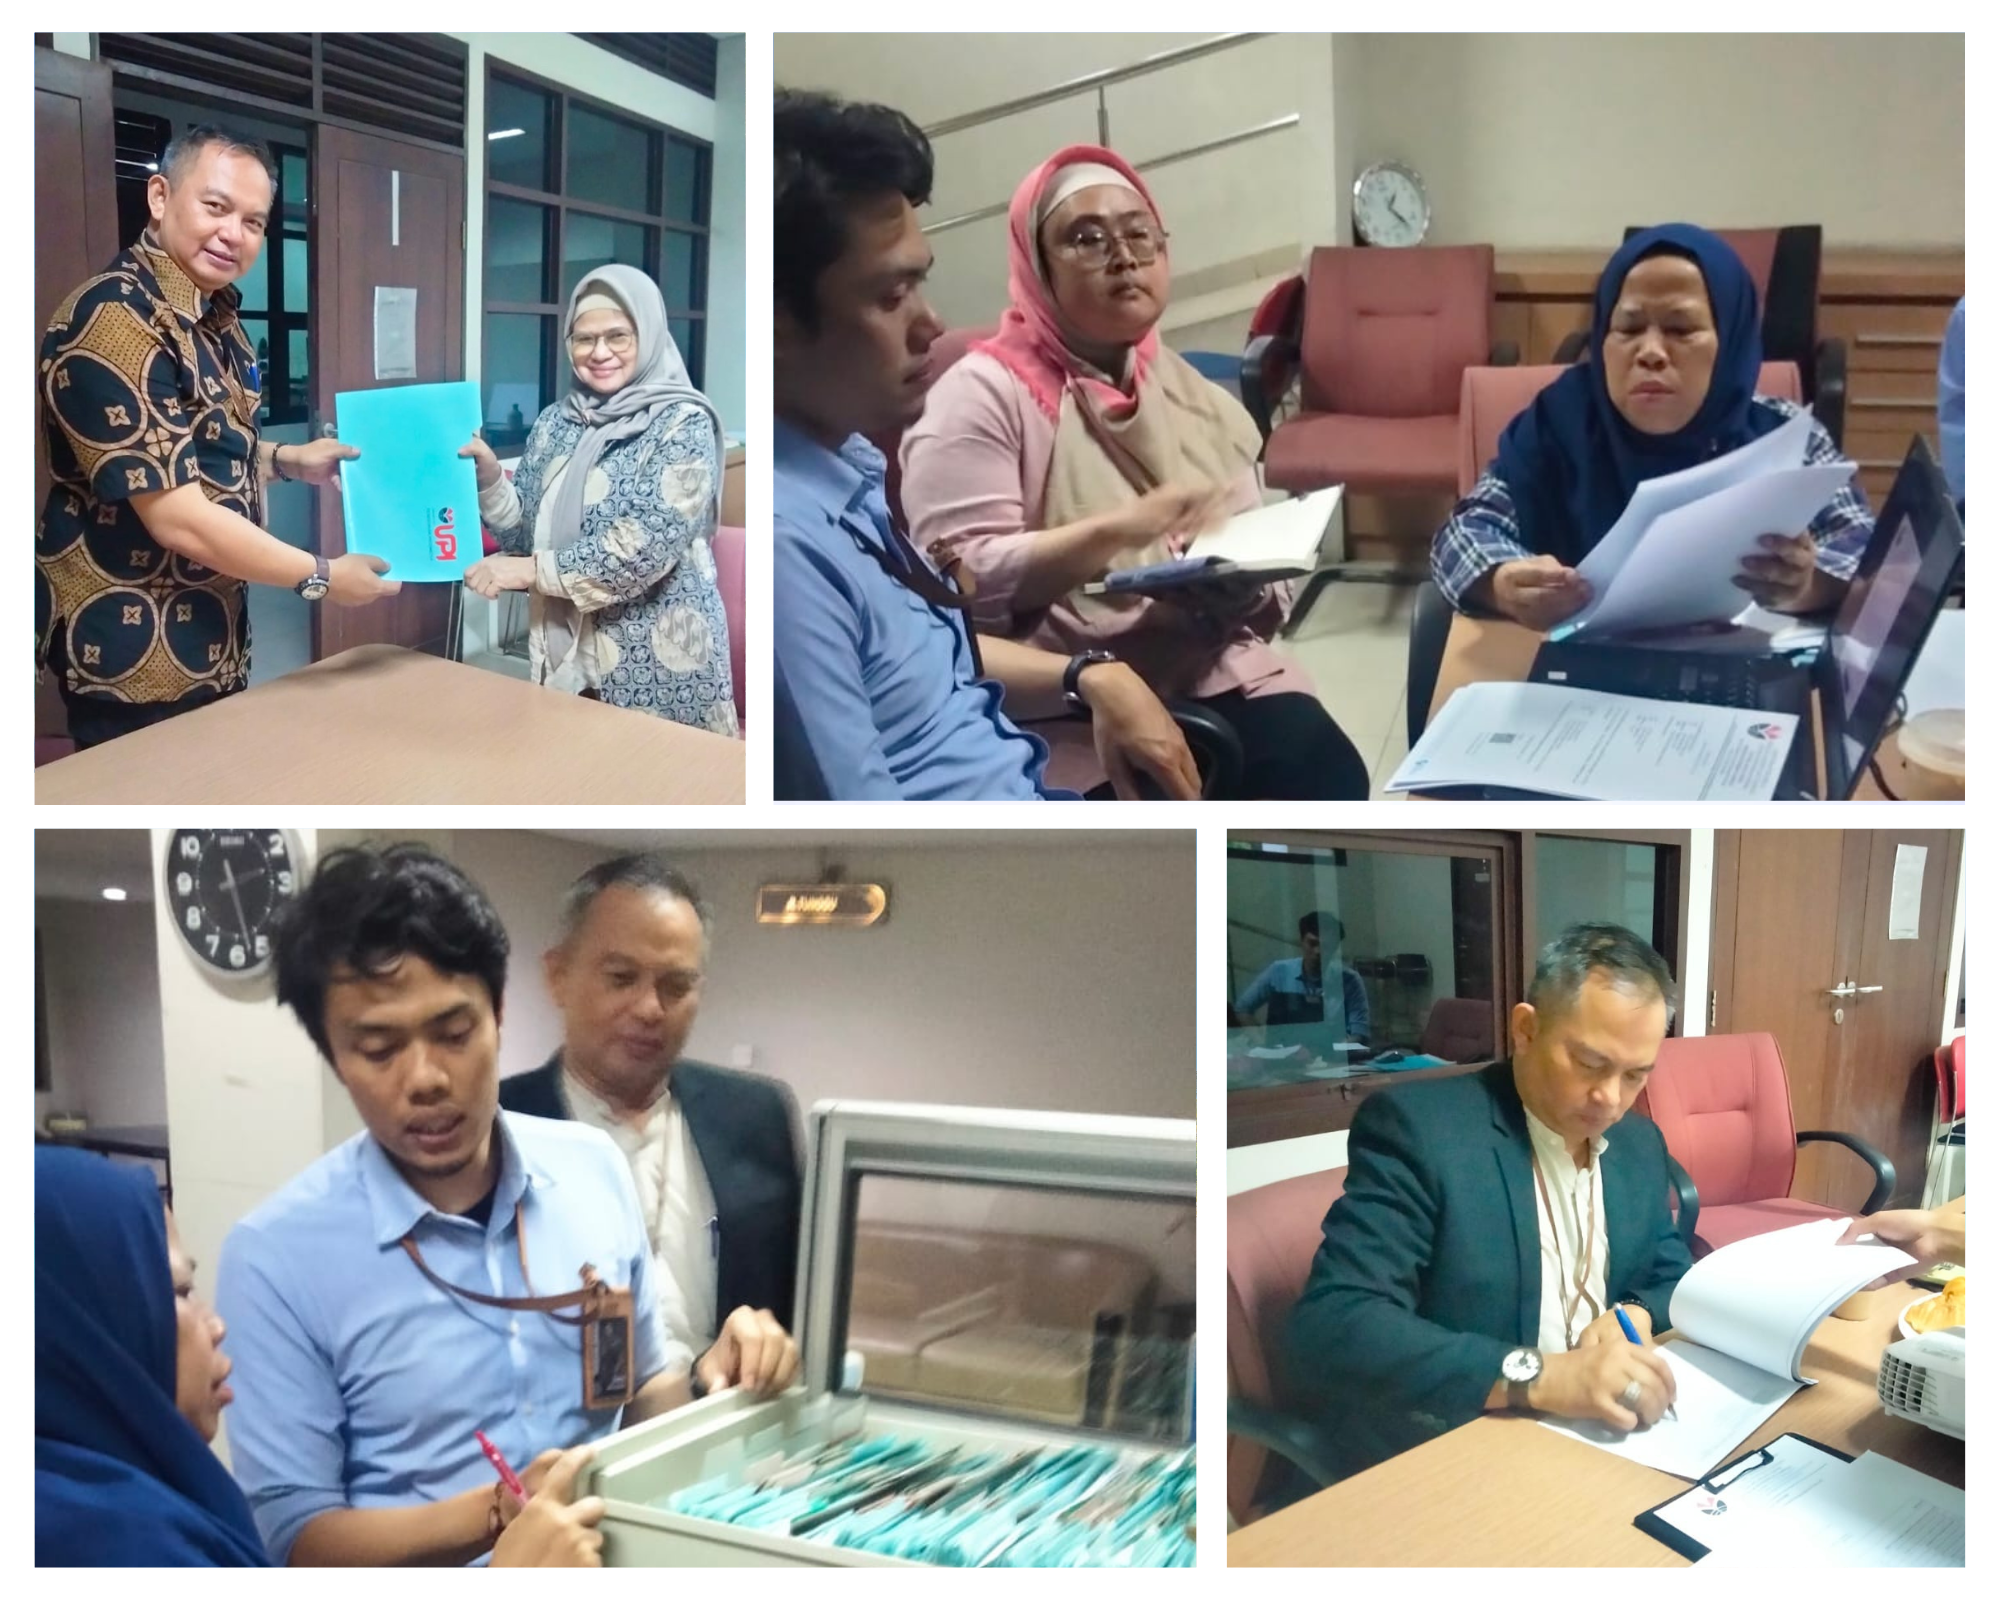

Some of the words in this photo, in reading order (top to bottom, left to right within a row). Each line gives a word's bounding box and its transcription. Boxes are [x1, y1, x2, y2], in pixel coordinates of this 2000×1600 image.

[180, 835, 200, 858] 10
[269, 834, 284, 855] 2
[278, 871, 292, 894] 3
[186, 906, 201, 930] 8
[205, 934, 220, 958] 7
[229, 944, 246, 967] 6
[255, 935, 270, 958] 5
